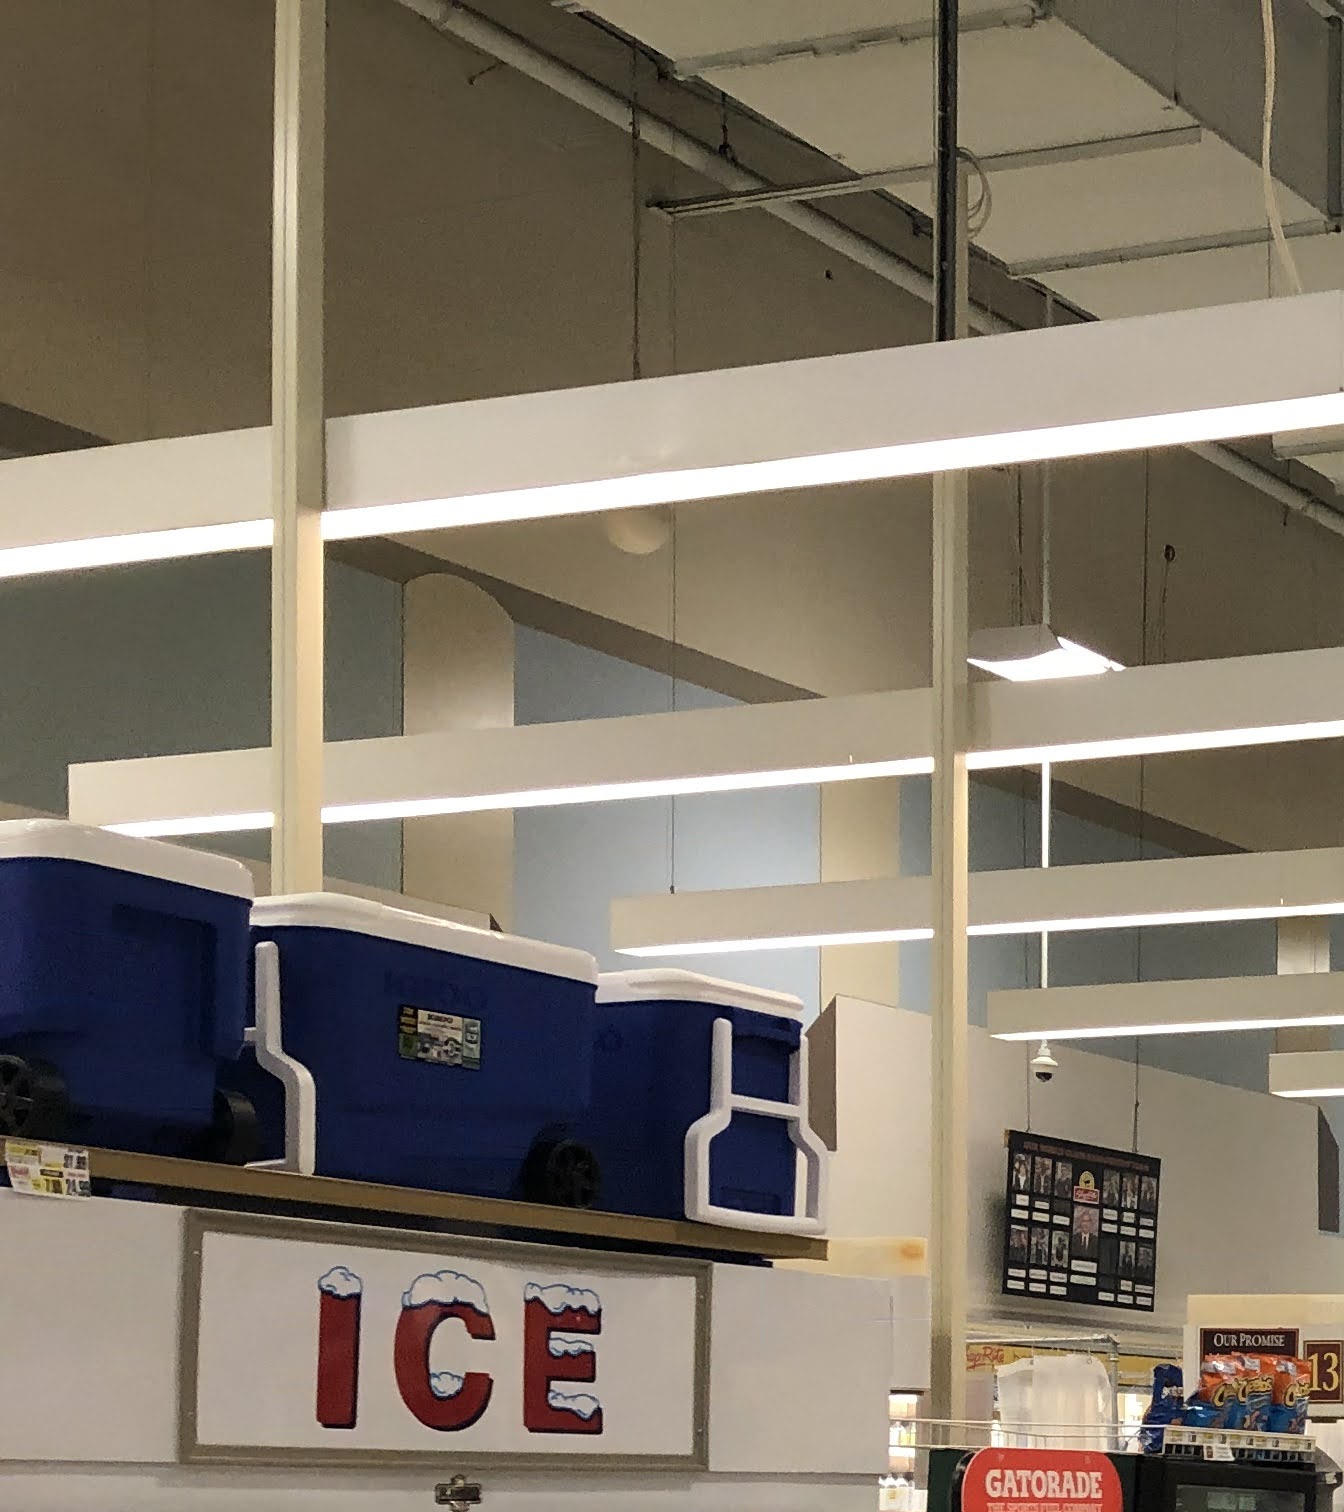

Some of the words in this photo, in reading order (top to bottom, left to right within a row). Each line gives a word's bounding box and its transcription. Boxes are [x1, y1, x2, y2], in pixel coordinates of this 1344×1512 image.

[316, 1265, 604, 1435] ICE
[1213, 1332, 1236, 1348] OUR
[1239, 1333, 1285, 1348] PROMISE
[1309, 1351, 1339, 1393] 13
[985, 1470, 1103, 1500] GATORADE
